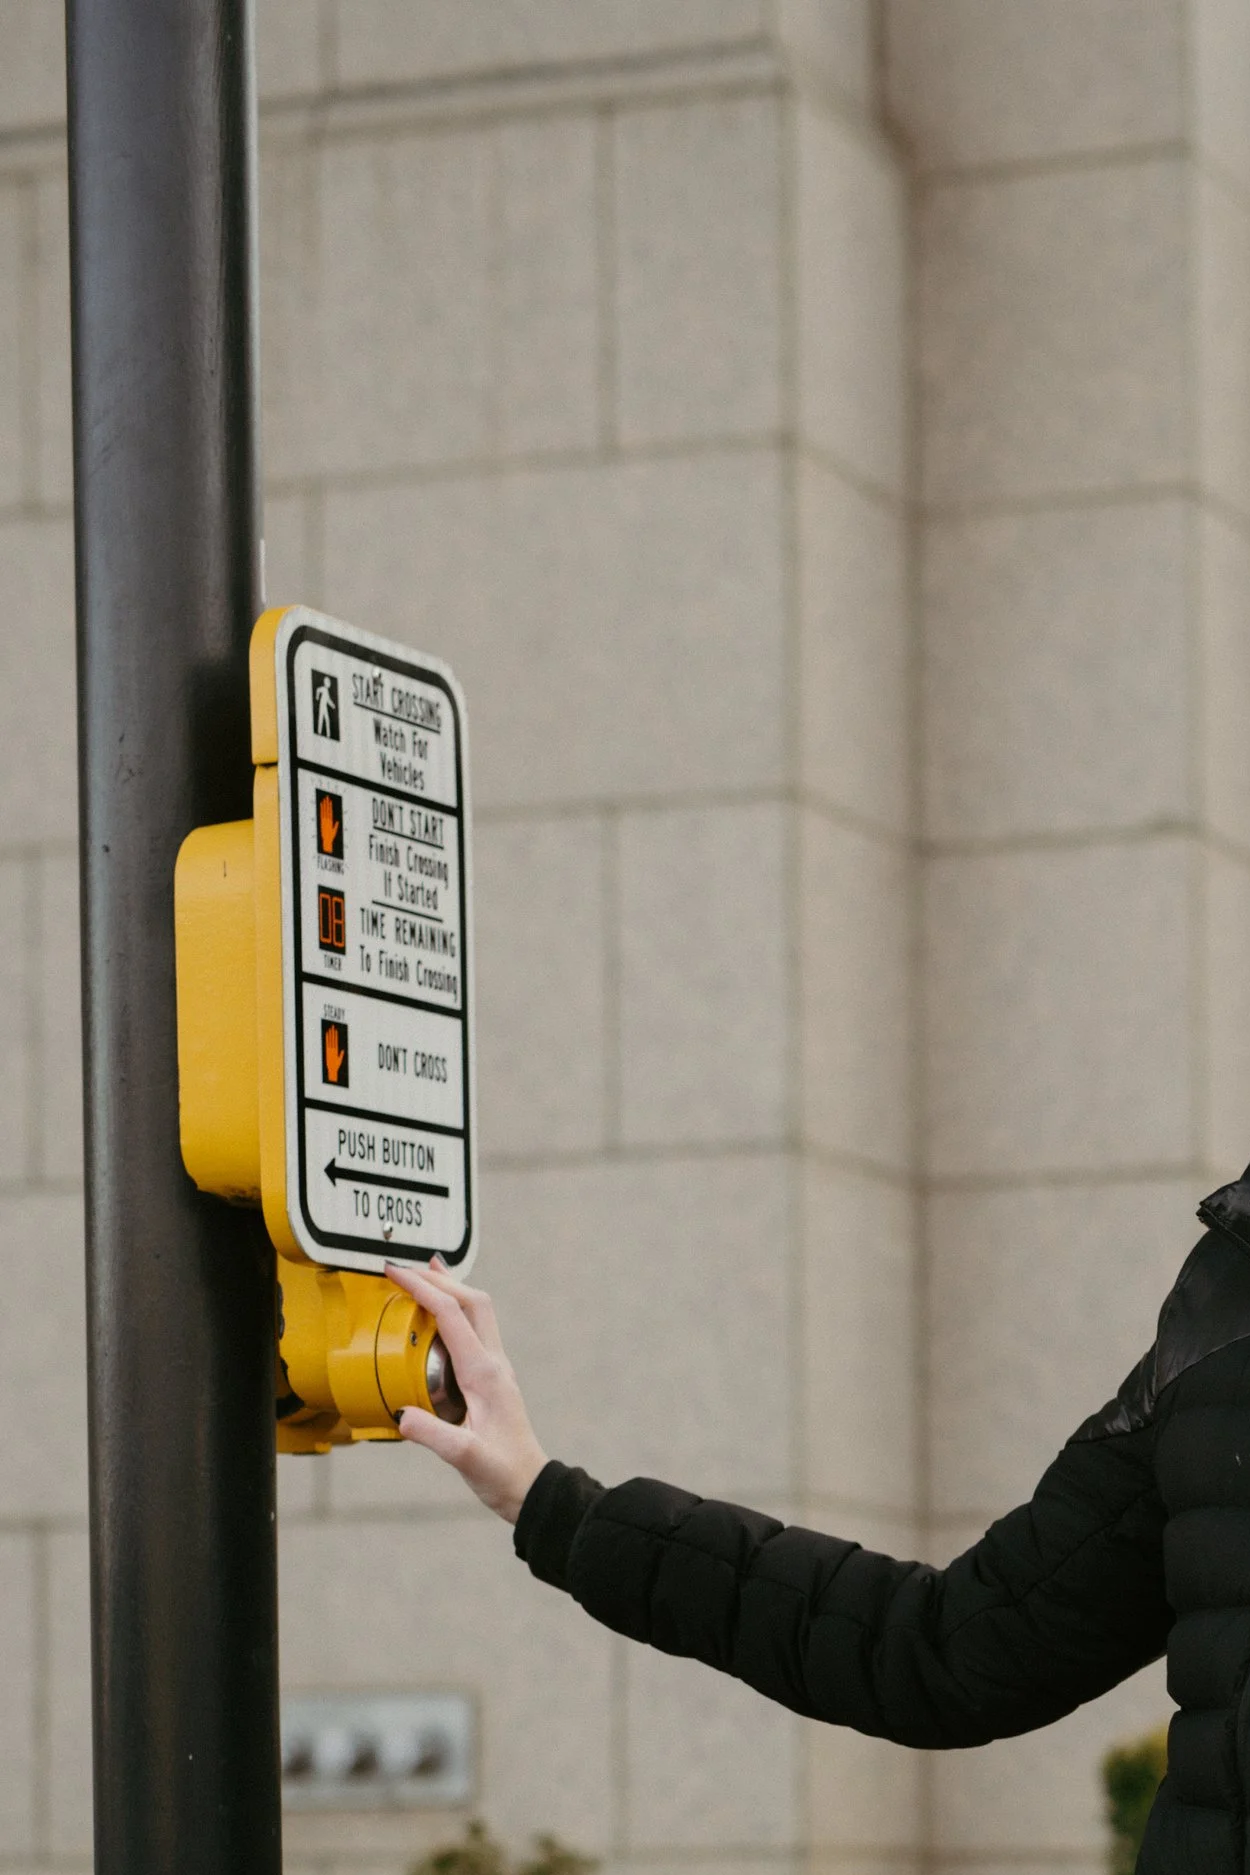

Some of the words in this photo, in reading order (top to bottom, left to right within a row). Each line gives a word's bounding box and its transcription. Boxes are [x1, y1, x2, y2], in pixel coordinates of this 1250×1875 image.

[352, 673, 384, 708] START
[391, 687, 442, 728] CROSSING
[373, 717, 406, 753] Watch
[412, 731, 428, 760] For
[380, 751, 425, 790] Vehicles
[372, 798, 403, 834] DON'T
[410, 809, 444, 846] START
[369, 834, 400, 868] Finish
[407, 845, 449, 890] Crossing
[384, 870, 392, 898] If
[397, 873, 439, 911] Started
[360, 907, 387, 940] TIME
[395, 916, 456, 958] REMAINING
[360, 944, 371, 973] To
[379, 949, 410, 983] Finish
[416, 959, 458, 1003] Crossing
[323, 1003, 346, 1021] STEADY
[378, 1042, 408, 1076] DON'T
[414, 1051, 448, 1084] CROSS
[338, 1128, 376, 1163] PUSH
[382, 1136, 435, 1173] BUTTON
[353, 1188, 370, 1219] TO
[377, 1193, 423, 1228] CROSS
